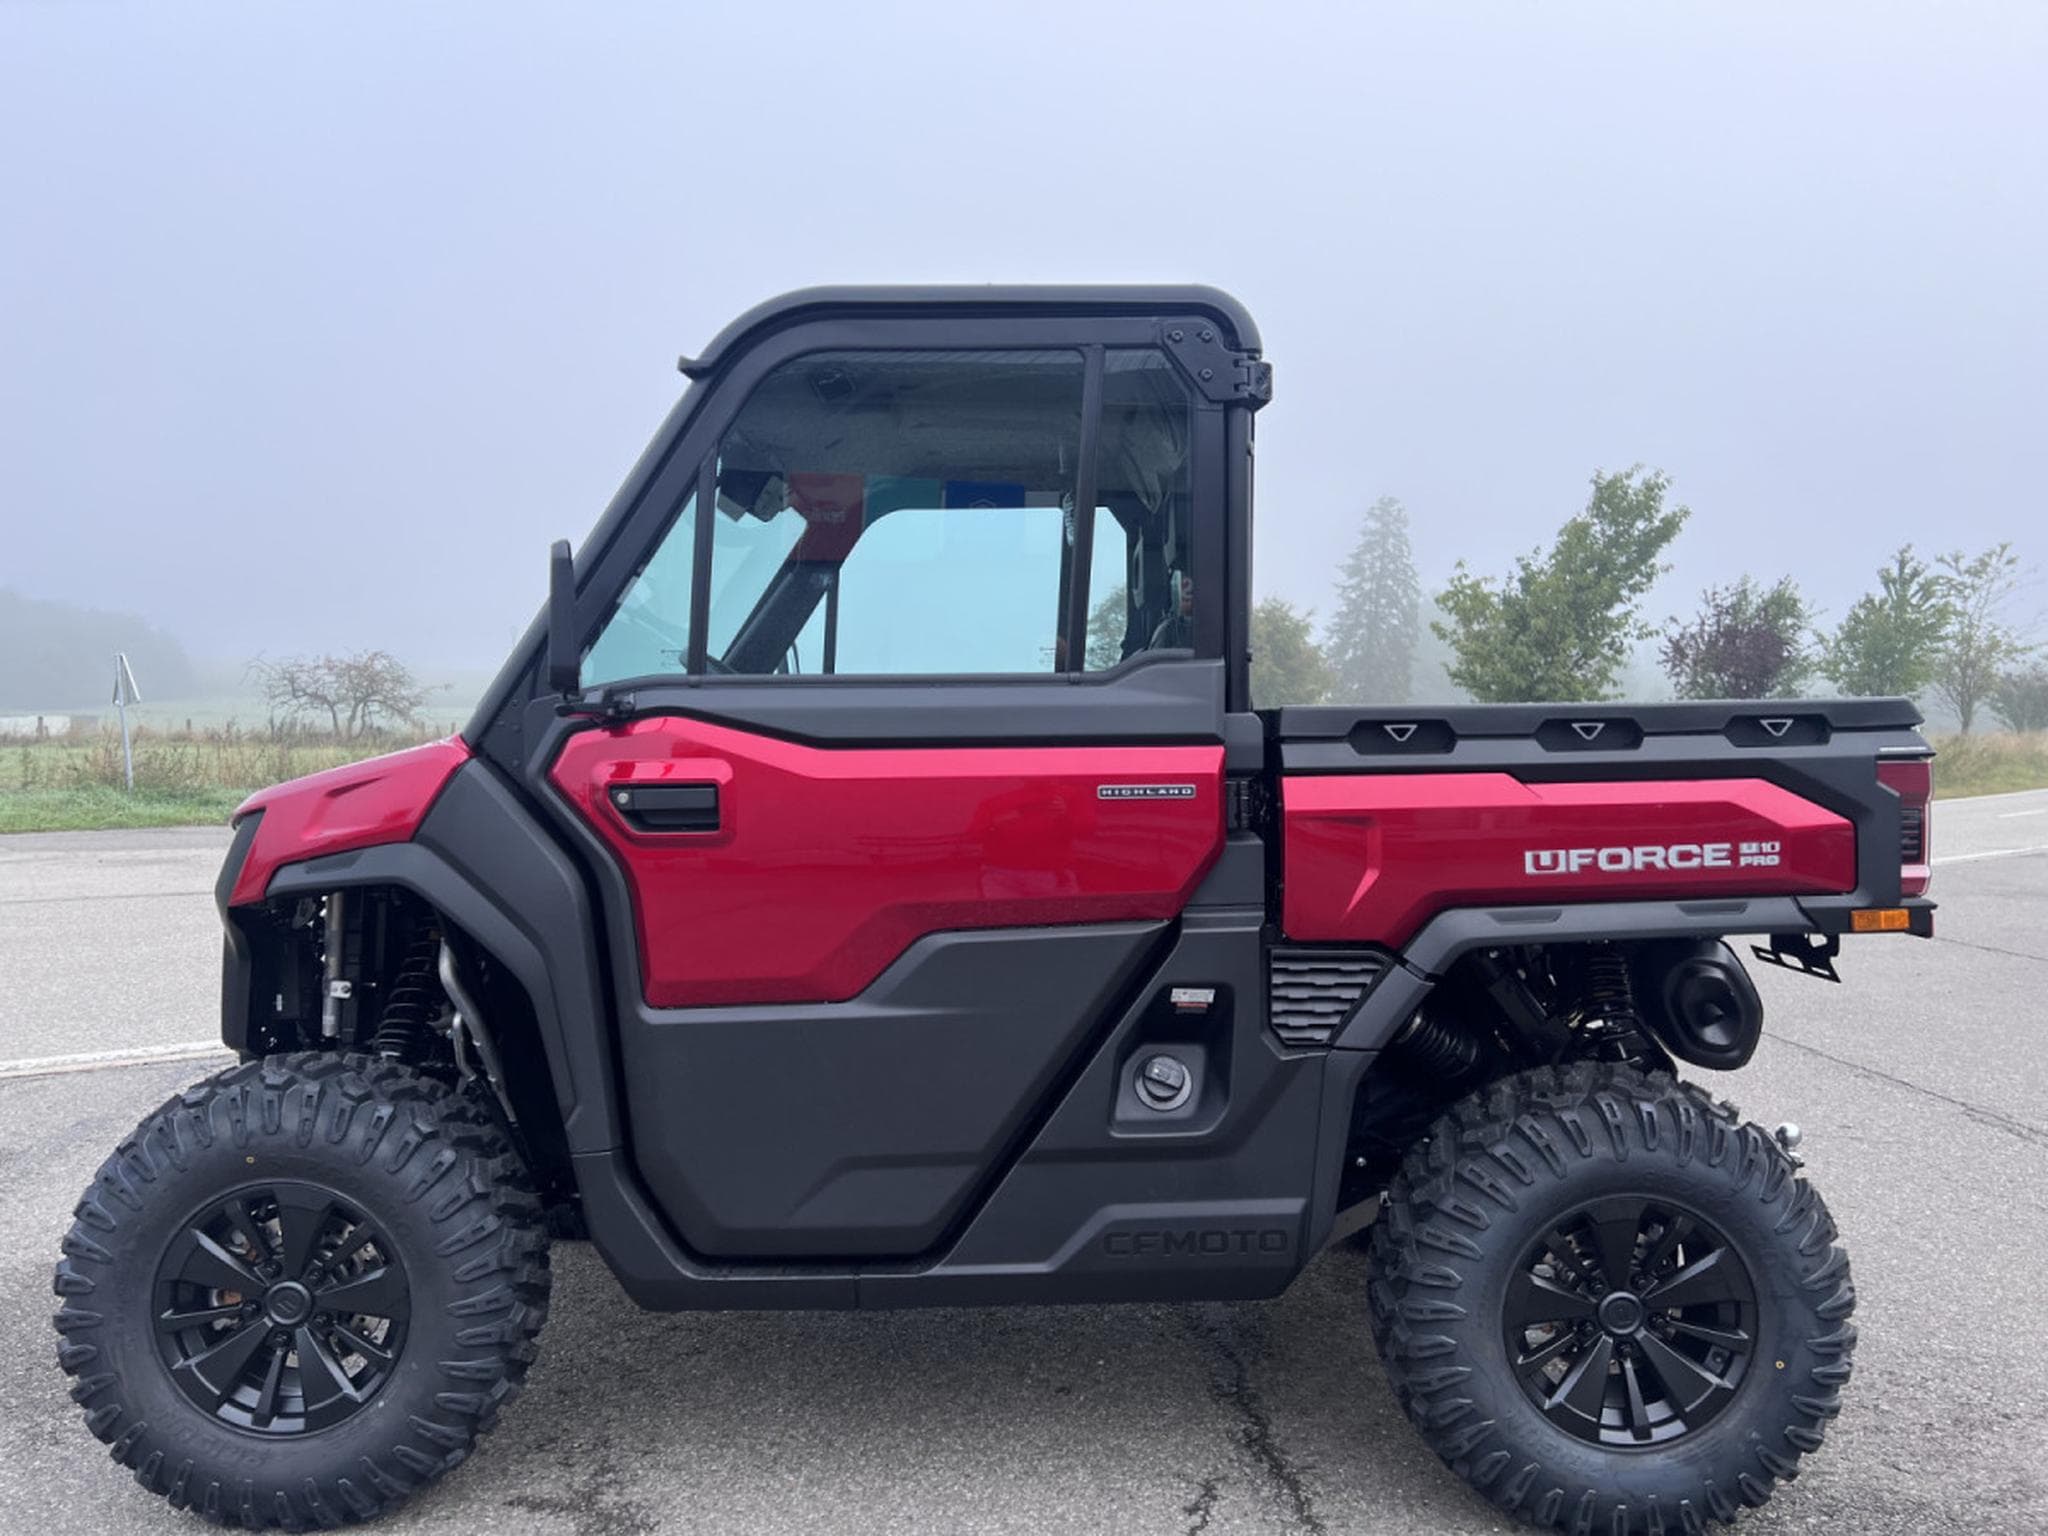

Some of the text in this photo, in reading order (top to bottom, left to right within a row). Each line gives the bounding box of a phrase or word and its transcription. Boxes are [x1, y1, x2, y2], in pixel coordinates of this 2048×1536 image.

[1101, 787, 1193, 797] HIGHLAND
[1740, 855, 1780, 866] PRO
[1104, 1229, 1288, 1256] CFMOTO
